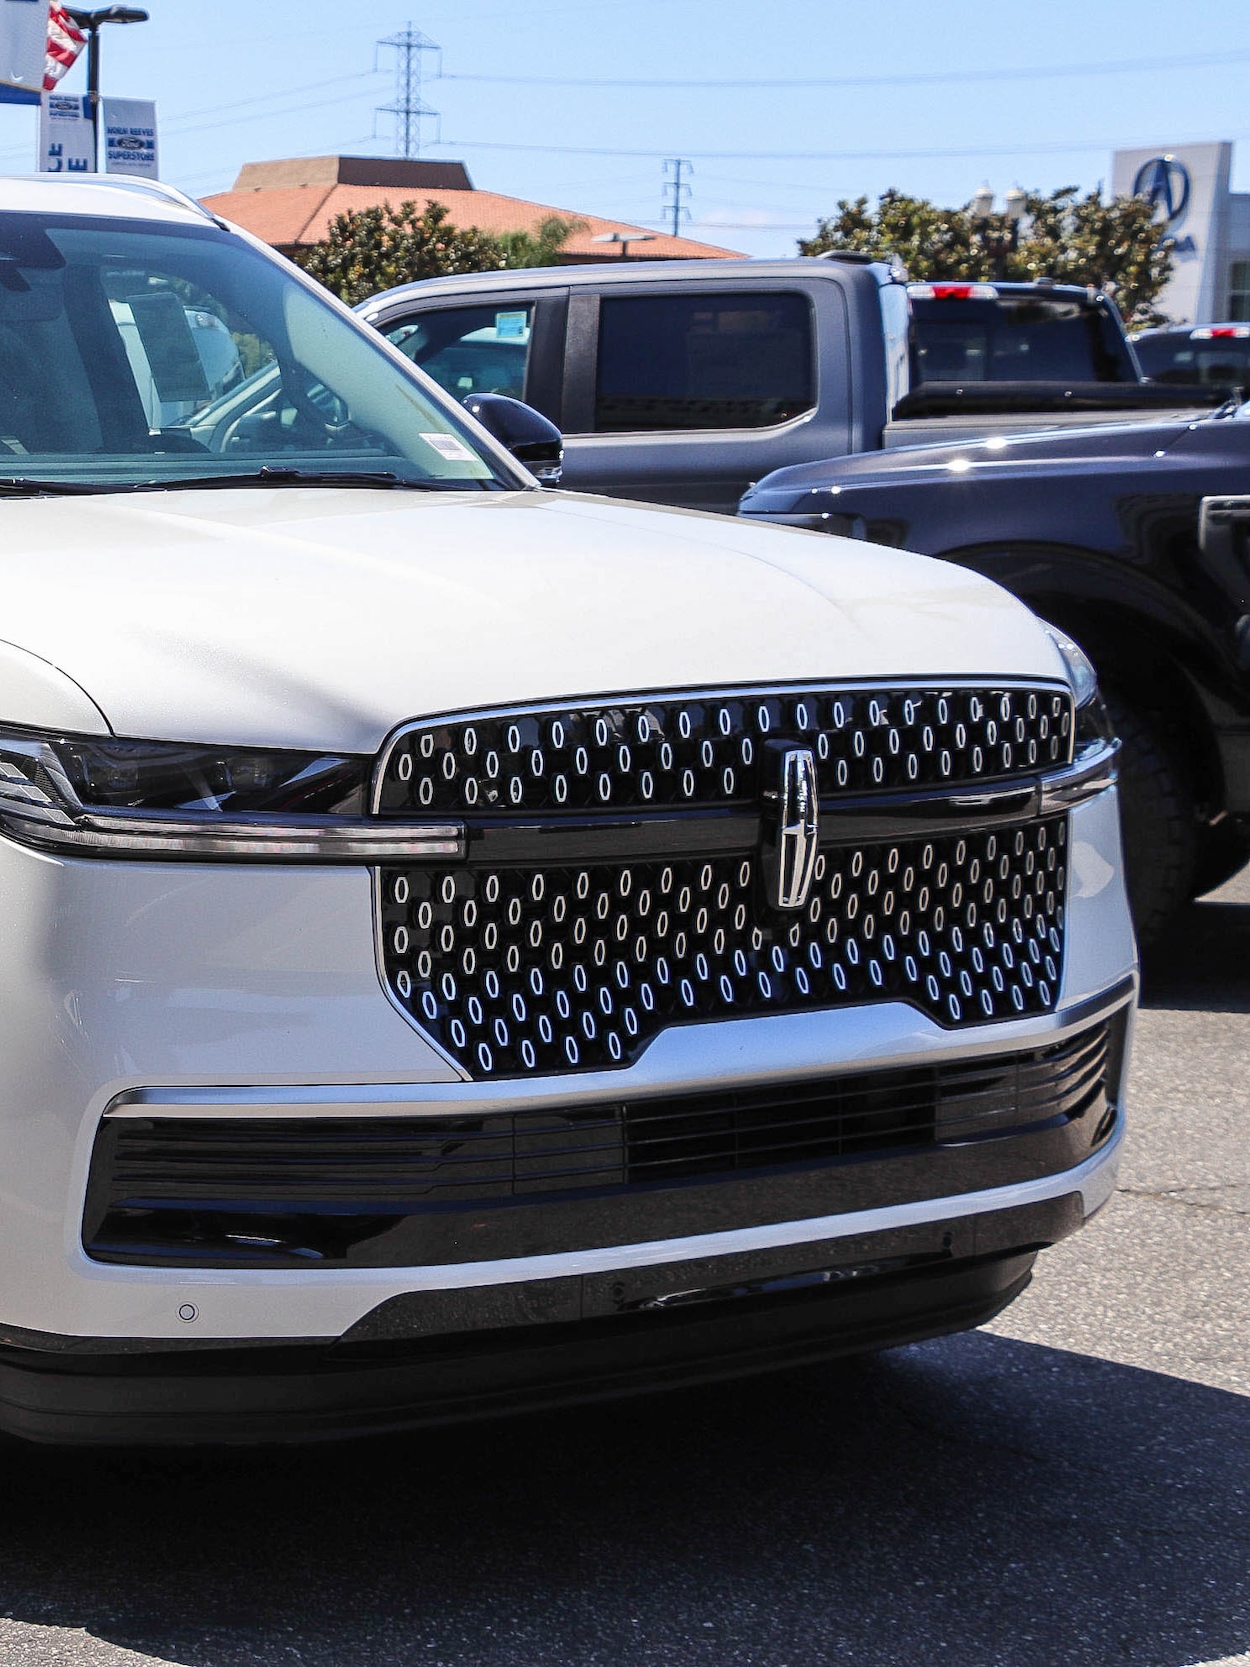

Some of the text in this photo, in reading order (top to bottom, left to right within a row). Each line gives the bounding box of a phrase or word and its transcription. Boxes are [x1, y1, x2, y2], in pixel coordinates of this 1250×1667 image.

[107, 126, 154, 137] NORM REEVES
[107, 150, 155, 161] SUPERSTORE
